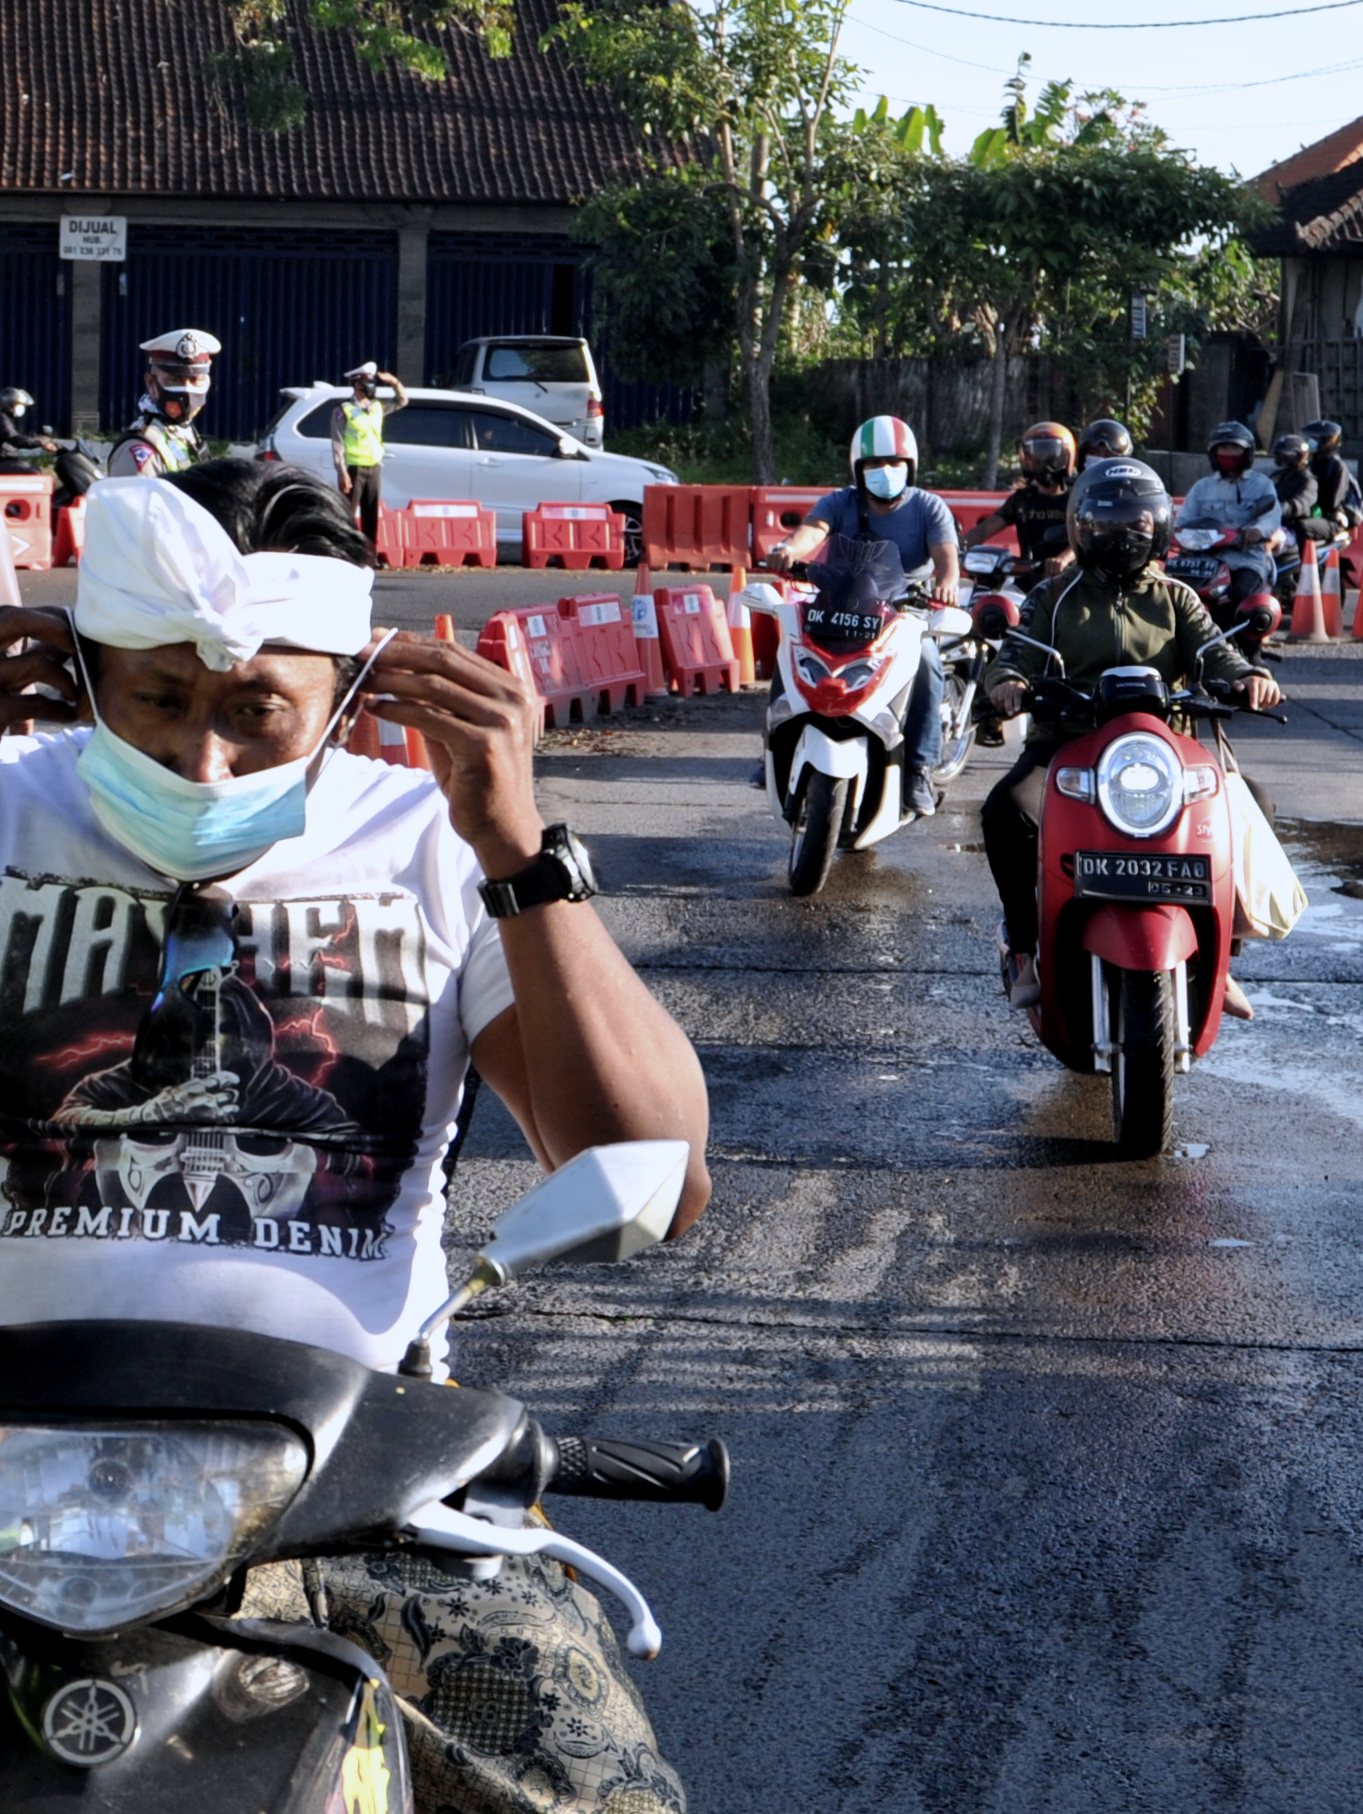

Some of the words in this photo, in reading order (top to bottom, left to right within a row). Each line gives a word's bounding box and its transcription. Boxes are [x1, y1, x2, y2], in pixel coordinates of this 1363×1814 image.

[68, 219, 117, 234] DIJUAL
[808, 608, 825, 623] DK
[831, 612, 859, 627] 4156
[863, 616, 880, 629] SY
[1083, 858, 1108, 875] DK
[1116, 859, 1162, 877] 2032
[3, 1206, 221, 1243] PREMIUM
[253, 1217, 387, 1260] DENIM
